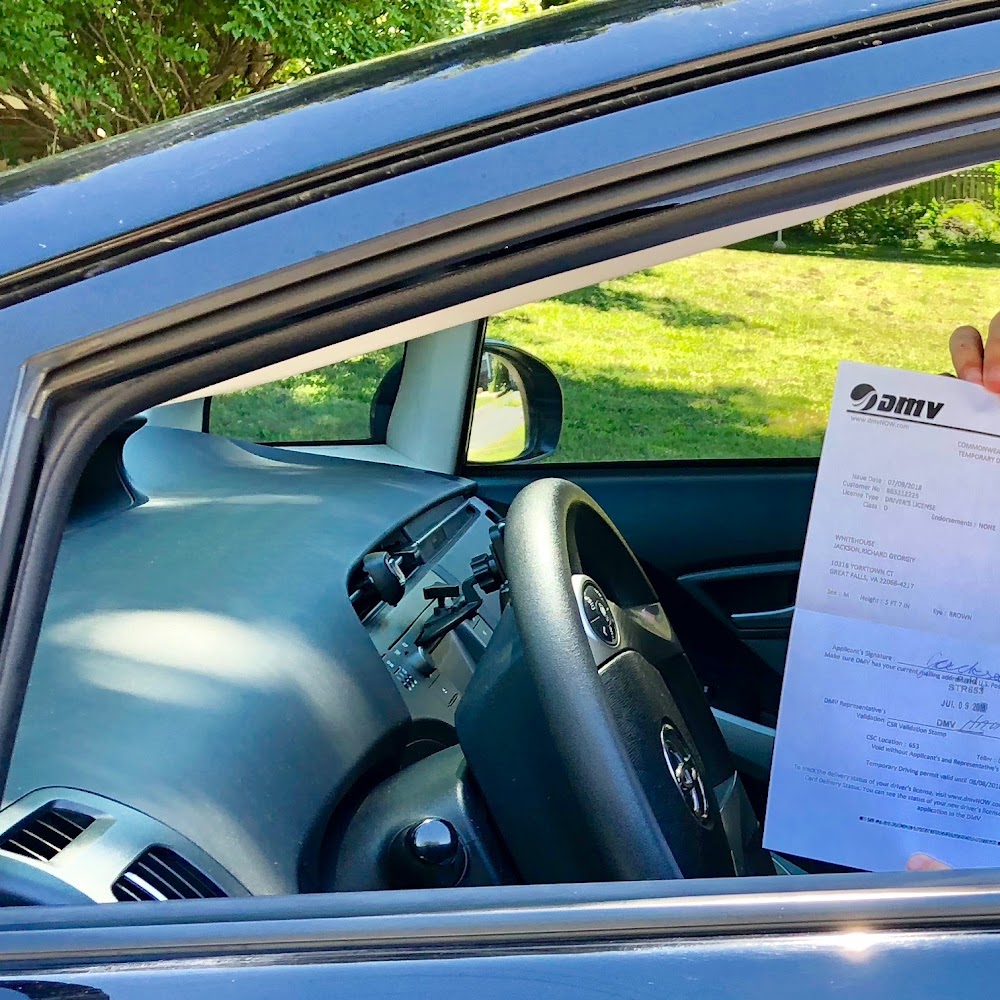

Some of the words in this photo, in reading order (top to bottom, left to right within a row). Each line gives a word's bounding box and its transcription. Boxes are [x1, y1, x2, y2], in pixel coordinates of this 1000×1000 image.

[877, 394, 943, 419] DMV
[958, 450, 995, 462] TEMPORARY
[842, 480, 871, 490] Customer
[851, 473, 867, 481] Issue
[868, 475, 882, 484] Date
[842, 488, 864, 498] License
[865, 492, 879, 503] Type
[912, 500, 936, 511] LICENSE
[931, 513, 972, 527] Endorsements
[978, 522, 996, 531] NONE
[835, 534, 875, 547] WHITEHOUSE
[829, 568, 849, 577] GREAT
[849, 563, 885, 576] YORKTOWN
[948, 611, 972, 620] BROWN
[832, 644, 863, 656] Applicant's
[864, 650, 892, 661] Signature
[824, 651, 841, 659] Make
[855, 657, 871, 665] DMV
[871, 659, 881, 667] has
[896, 665, 918, 675] current
[839, 700, 886, 715] Representative's
[856, 712, 885, 723] Validation
[936, 718, 956, 728] DMV
[899, 723, 927, 733] Validation
[928, 728, 947, 737] Stamp
[878, 736, 903, 746] Location
[871, 743, 885, 751] Void
[885, 747, 908, 755] without
[908, 751, 940, 761] Applicant's
[953, 759, 999, 773] Representative's
[976, 754, 992, 762] Teller
[866, 759, 897, 771] Temporary
[898, 765, 919, 776] Driving
[919, 769, 939, 778] permit
[954, 775, 968, 783] until
[802, 766, 816, 774] track
[826, 771, 850, 781] delivery
[890, 782, 911, 791] driver's
[935, 790, 947, 798] visit
[804, 774, 818, 782] Card
[818, 777, 841, 787] Delivery
[862, 785, 874, 793] You
[907, 795, 925, 803] status
[945, 801, 960, 809] new
[959, 803, 981, 813] driver's
[916, 806, 947, 815] application
